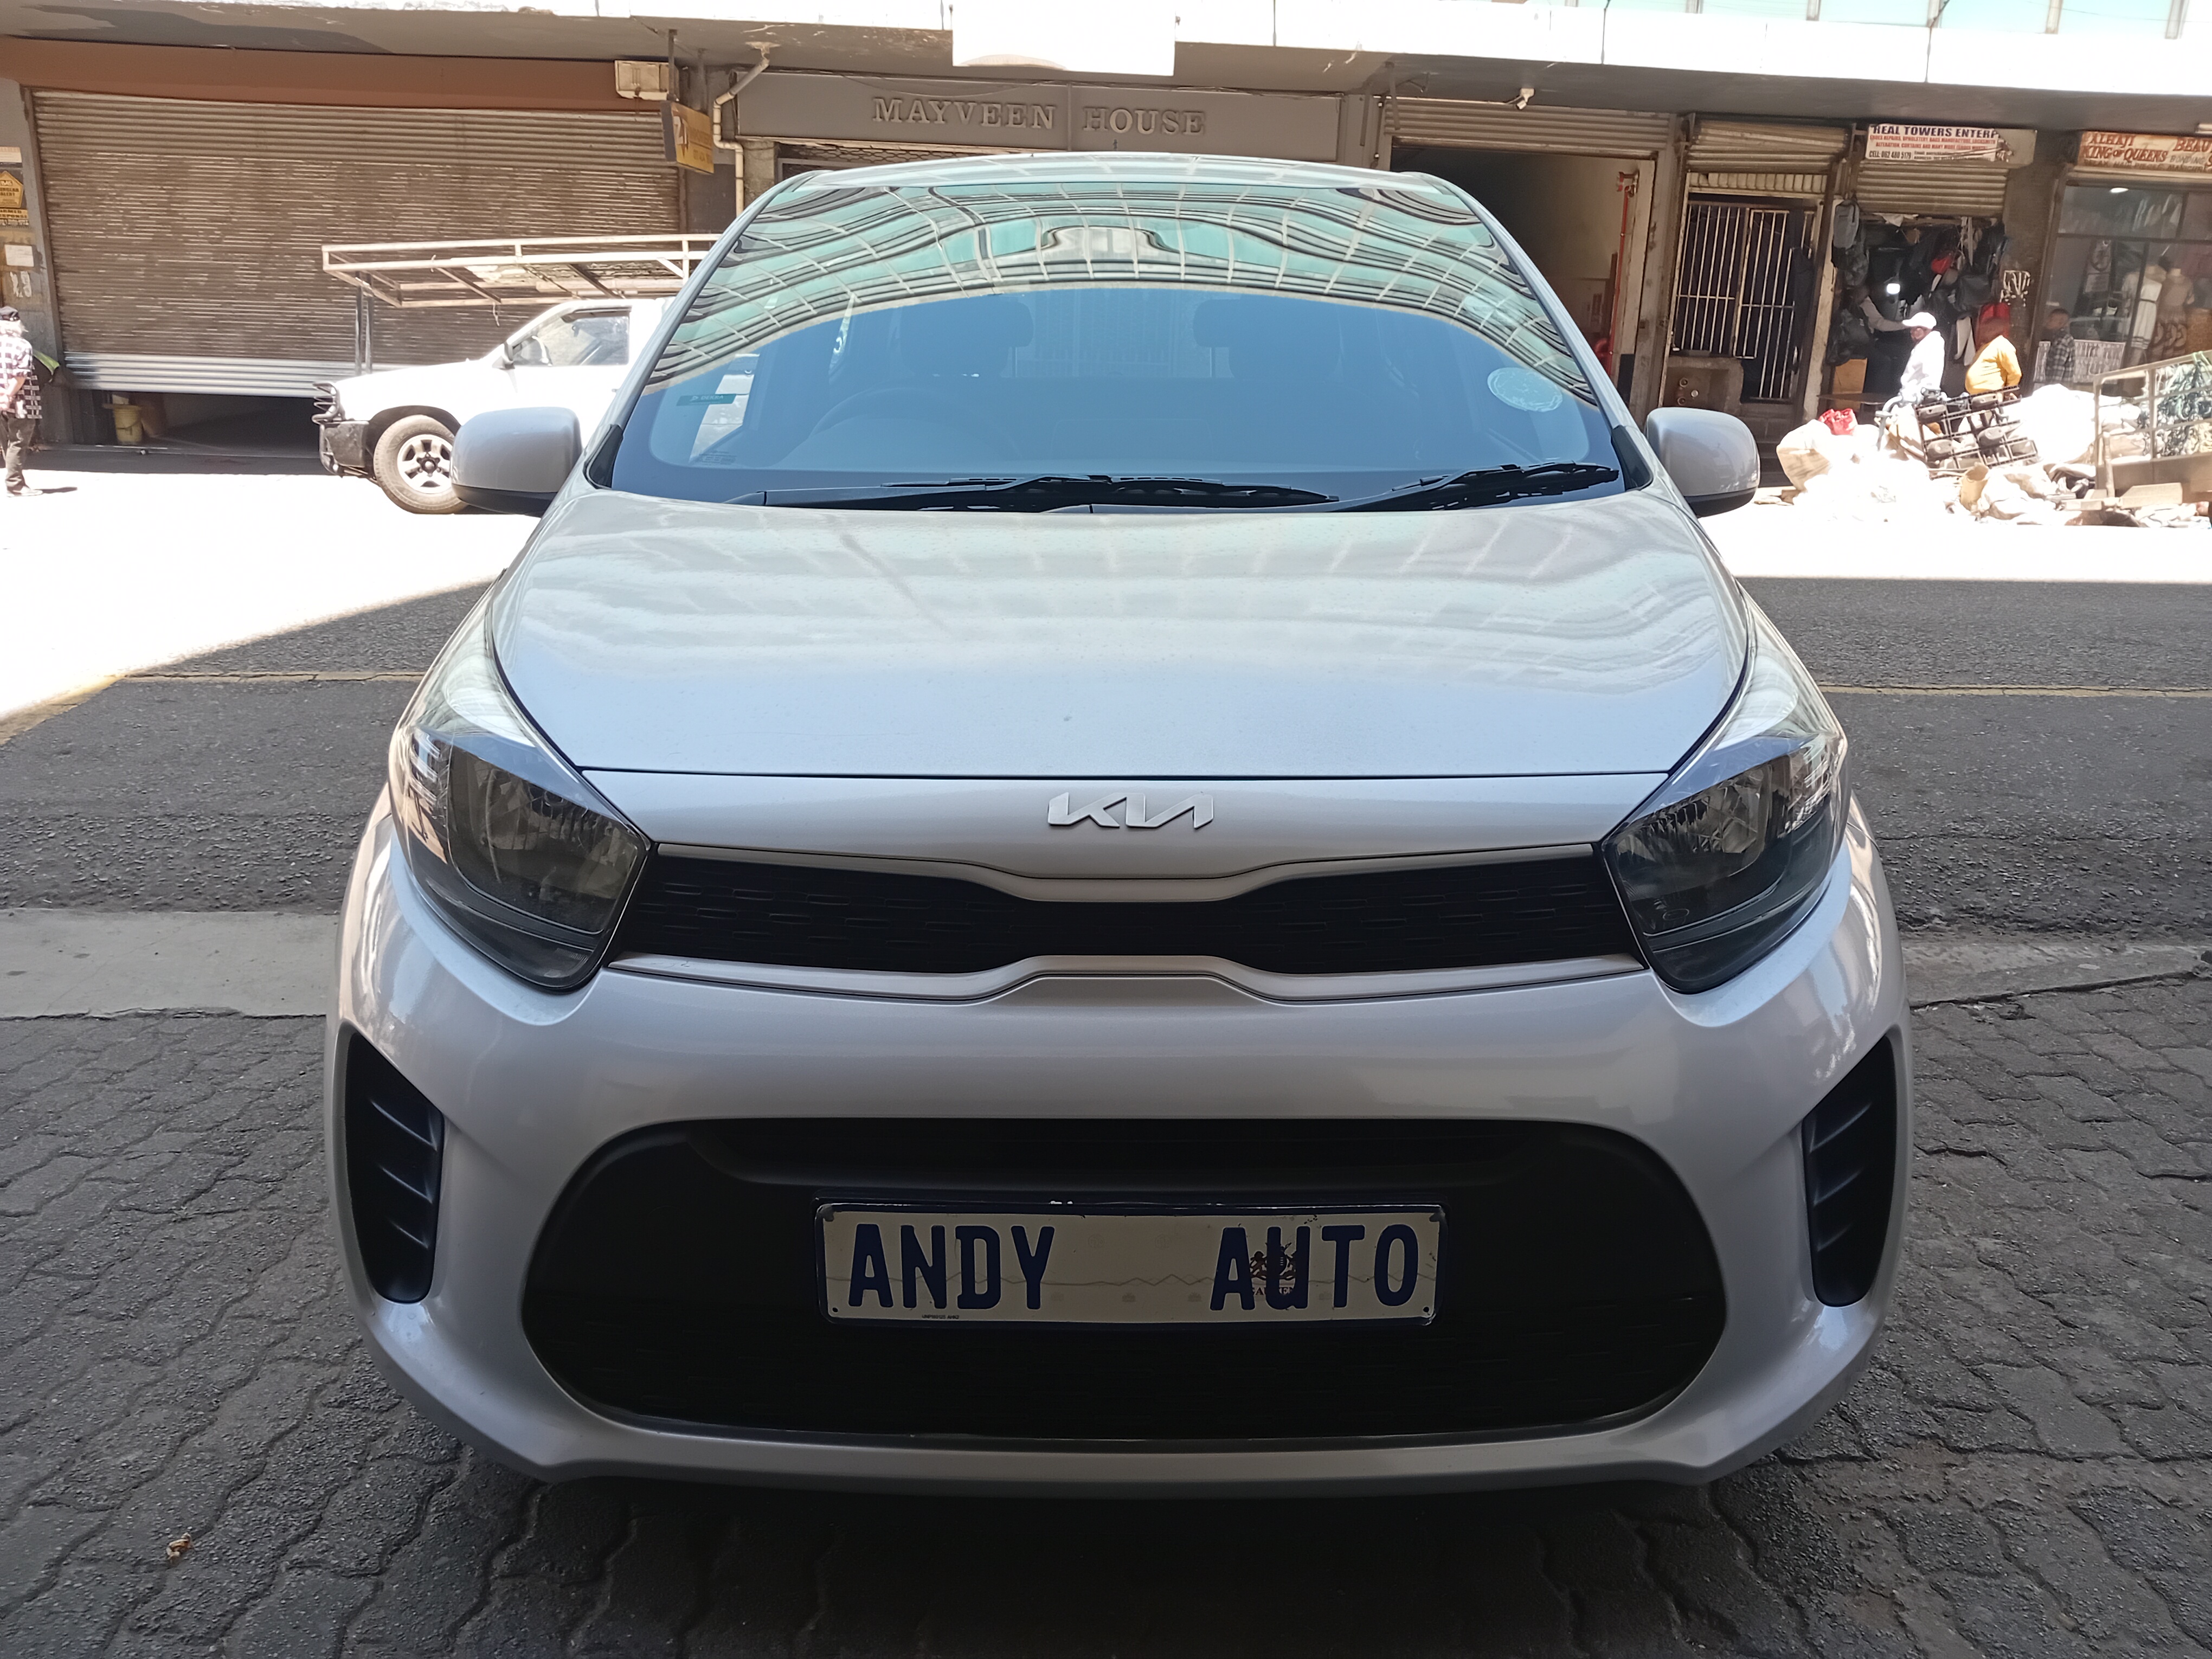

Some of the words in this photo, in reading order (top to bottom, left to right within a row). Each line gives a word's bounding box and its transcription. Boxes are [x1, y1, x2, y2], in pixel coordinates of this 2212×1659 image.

[872, 98, 1057, 130] MAYVEEN
[1083, 106, 1206, 136] HOUSE
[1904, 126, 1952, 137] TOWERS
[2081, 145, 2113, 159] KING
[2124, 147, 2169, 163] QUEENS
[1047, 792, 1214, 829] KIA
[848, 1223, 1055, 1310] ANDY
[1210, 1224, 1419, 1311] AUTO
